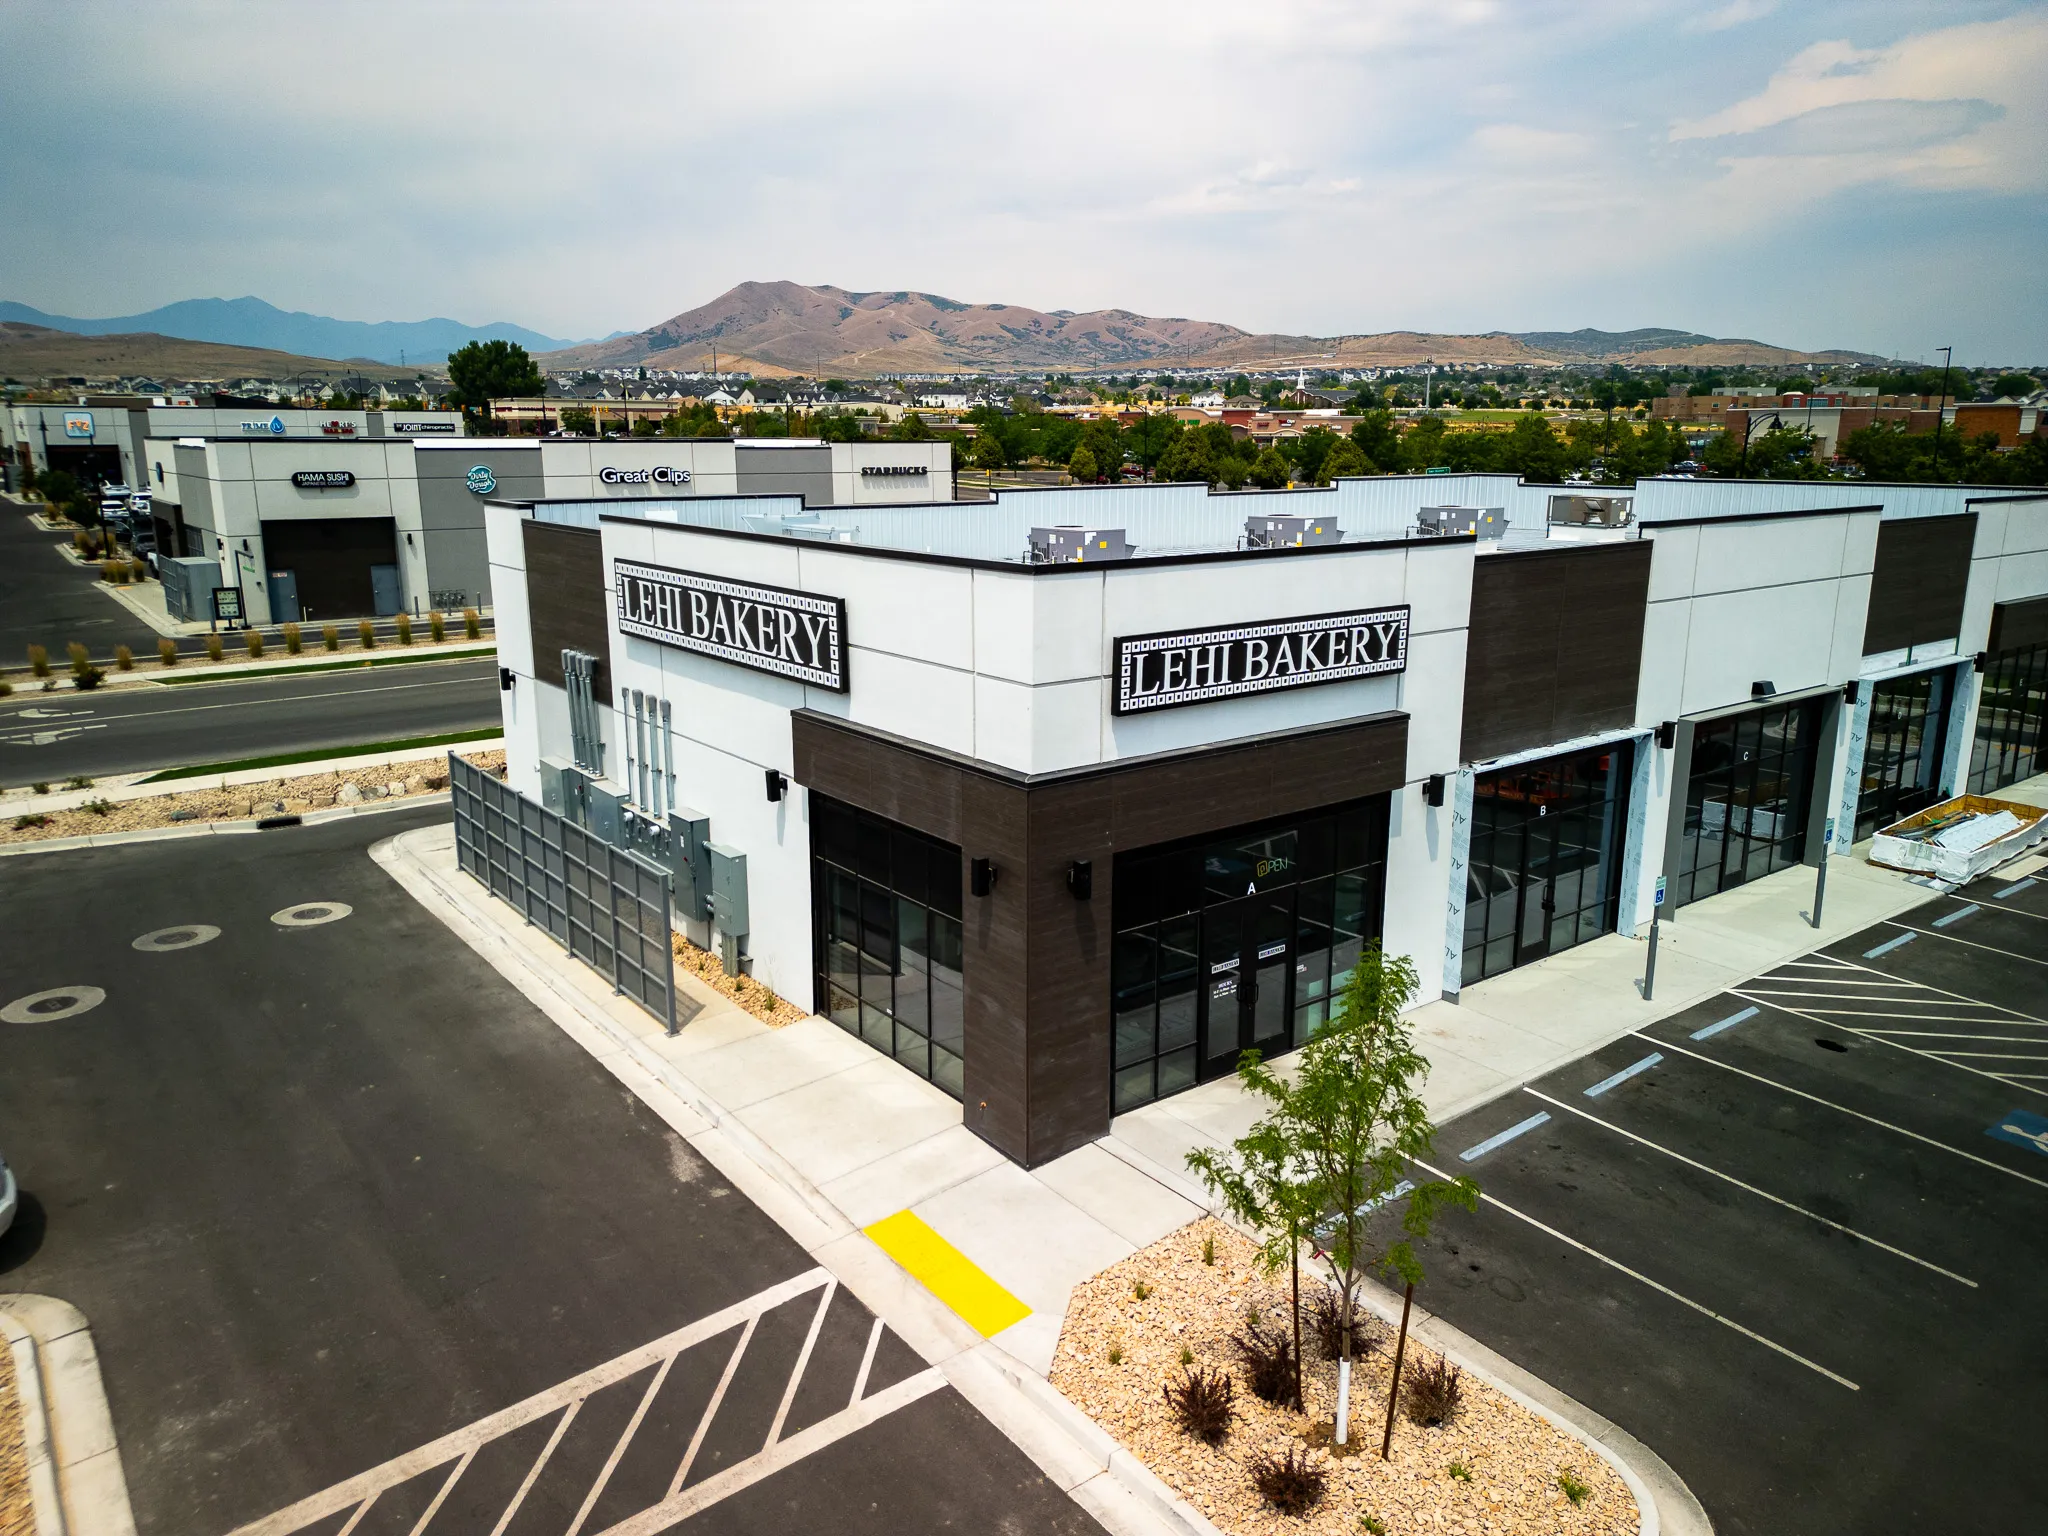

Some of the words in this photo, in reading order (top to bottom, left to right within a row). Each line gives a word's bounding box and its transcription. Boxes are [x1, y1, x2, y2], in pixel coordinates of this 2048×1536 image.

[241, 421, 270, 430] PRIME
[402, 423, 422, 431] JOINT
[470, 471, 488, 481] Dirty
[601, 467, 649, 483] Great
[653, 467, 691, 486] Clips
[861, 466, 928, 476] STARBUCKS
[297, 473, 325, 481] HAMA
[326, 473, 349, 481] SUSHI
[469, 479, 492, 491] Dough
[621, 577, 684, 634] LEHI
[688, 590, 829, 669] BAKERY
[1131, 643, 1232, 697] LEHI
[1241, 622, 1400, 682] BAKERY
[1743, 751, 1749, 761] C
[1540, 805, 1547, 816] B
[1257, 857, 1288, 877] OPEN
[1247, 881, 1256, 896] A
